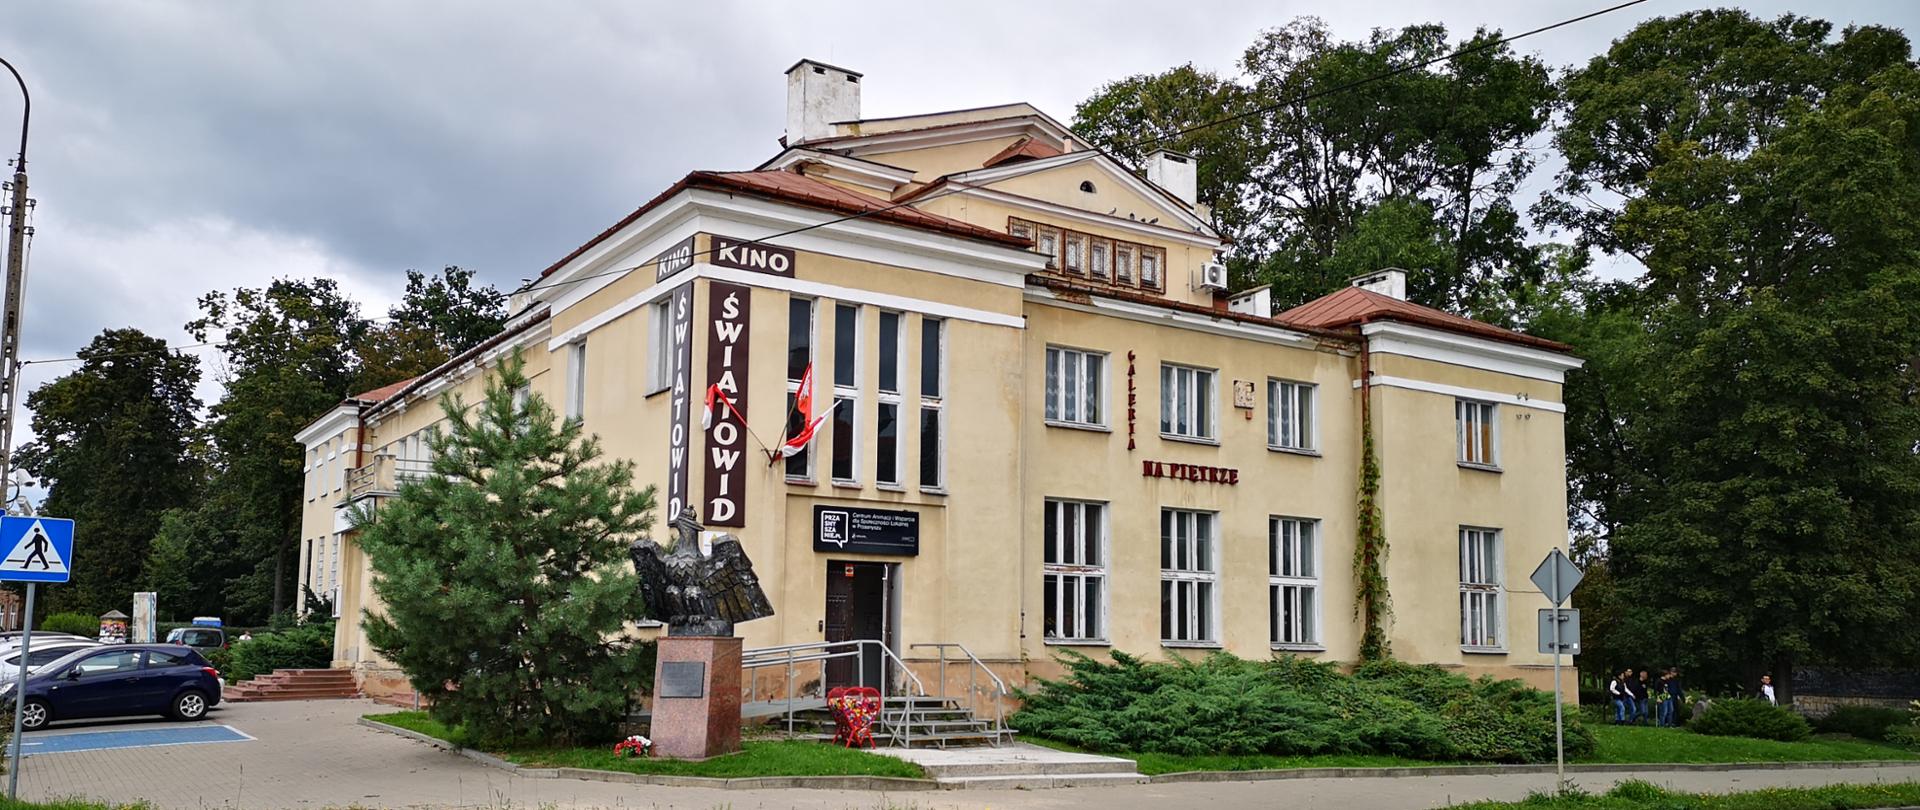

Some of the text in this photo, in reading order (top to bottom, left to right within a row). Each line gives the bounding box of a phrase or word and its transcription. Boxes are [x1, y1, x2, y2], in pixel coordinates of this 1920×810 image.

[659, 245, 690, 278] KINO
[718, 241, 789, 273] KINO
[669, 292, 687, 522] ŚWIATOWID
[710, 292, 744, 522] ŚWIATOWID
[1127, 349, 1136, 451] GALERIA
[1142, 460, 1163, 478] NA
